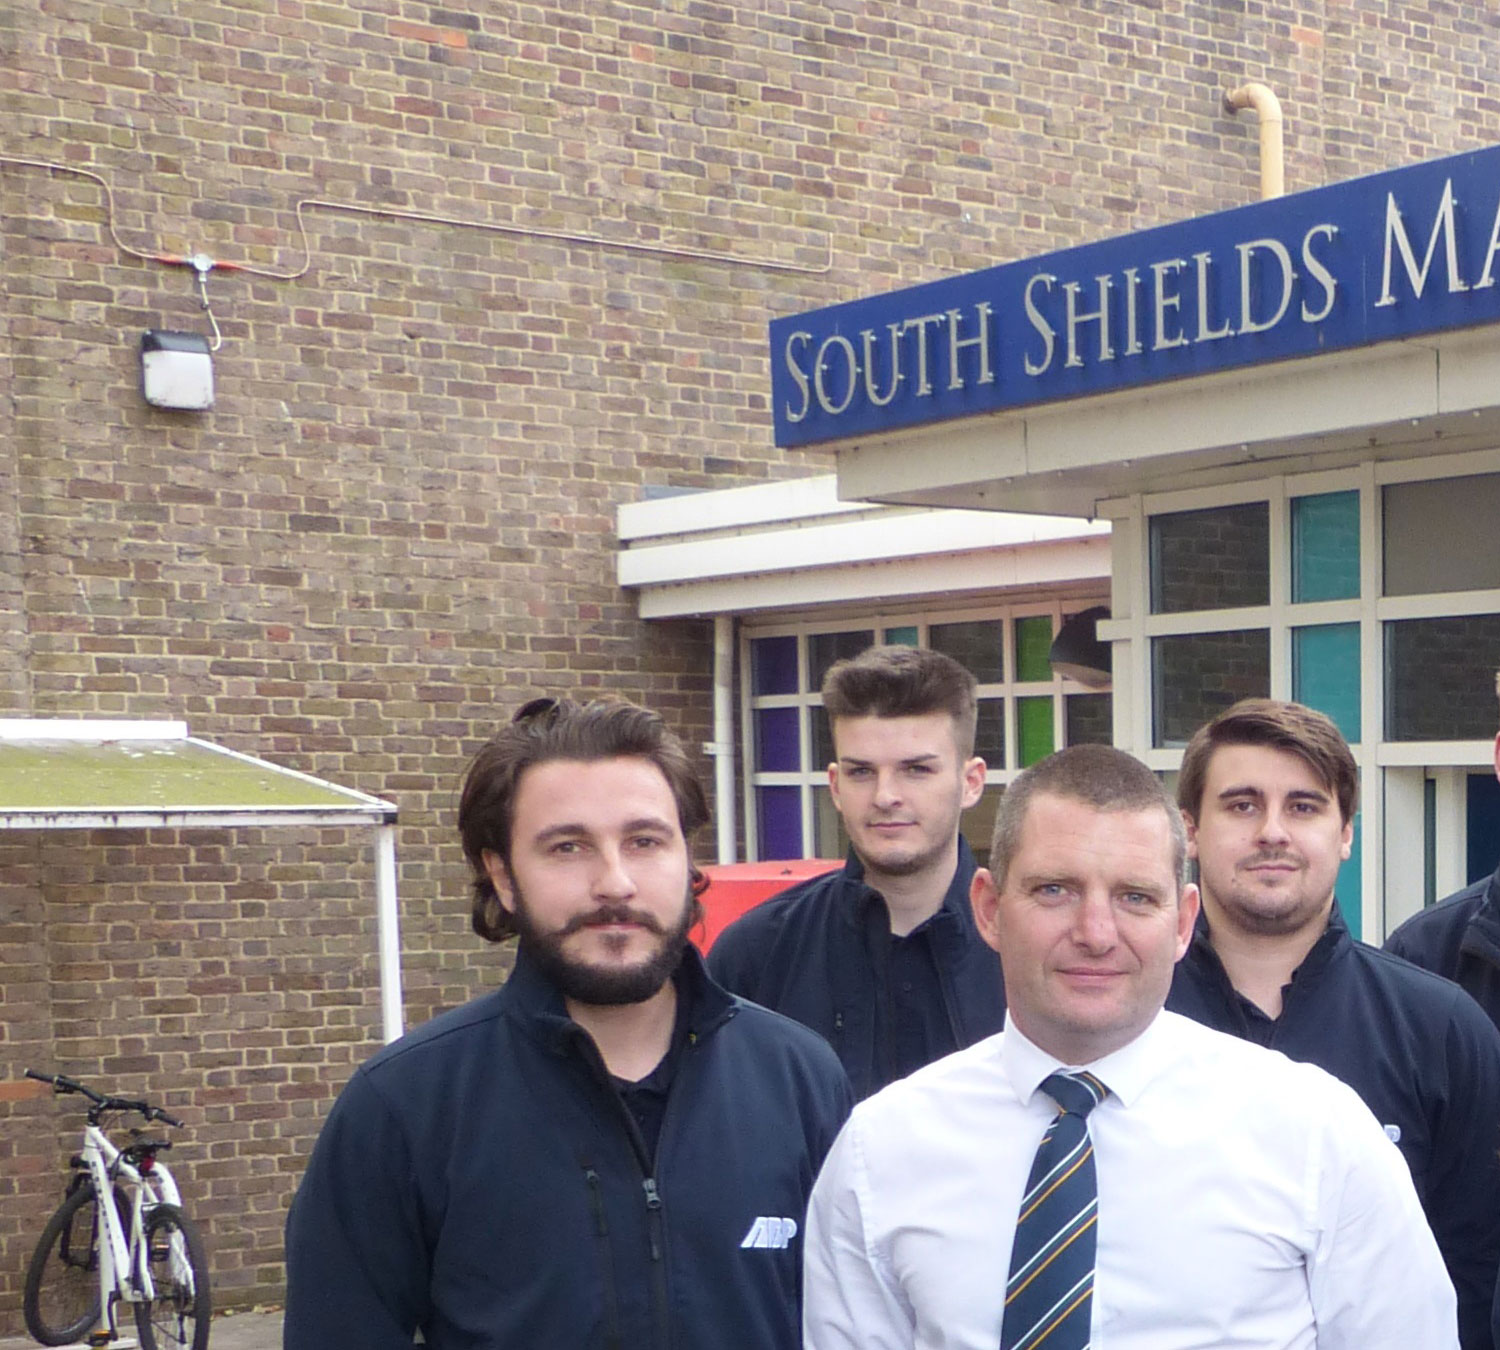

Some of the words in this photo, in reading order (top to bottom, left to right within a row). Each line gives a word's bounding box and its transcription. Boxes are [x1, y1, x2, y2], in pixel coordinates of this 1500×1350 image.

[785, 301, 995, 423] SOUTH
[1023, 223, 1340, 377] SHIELDS
[741, 1216, 797, 1249] ABP
